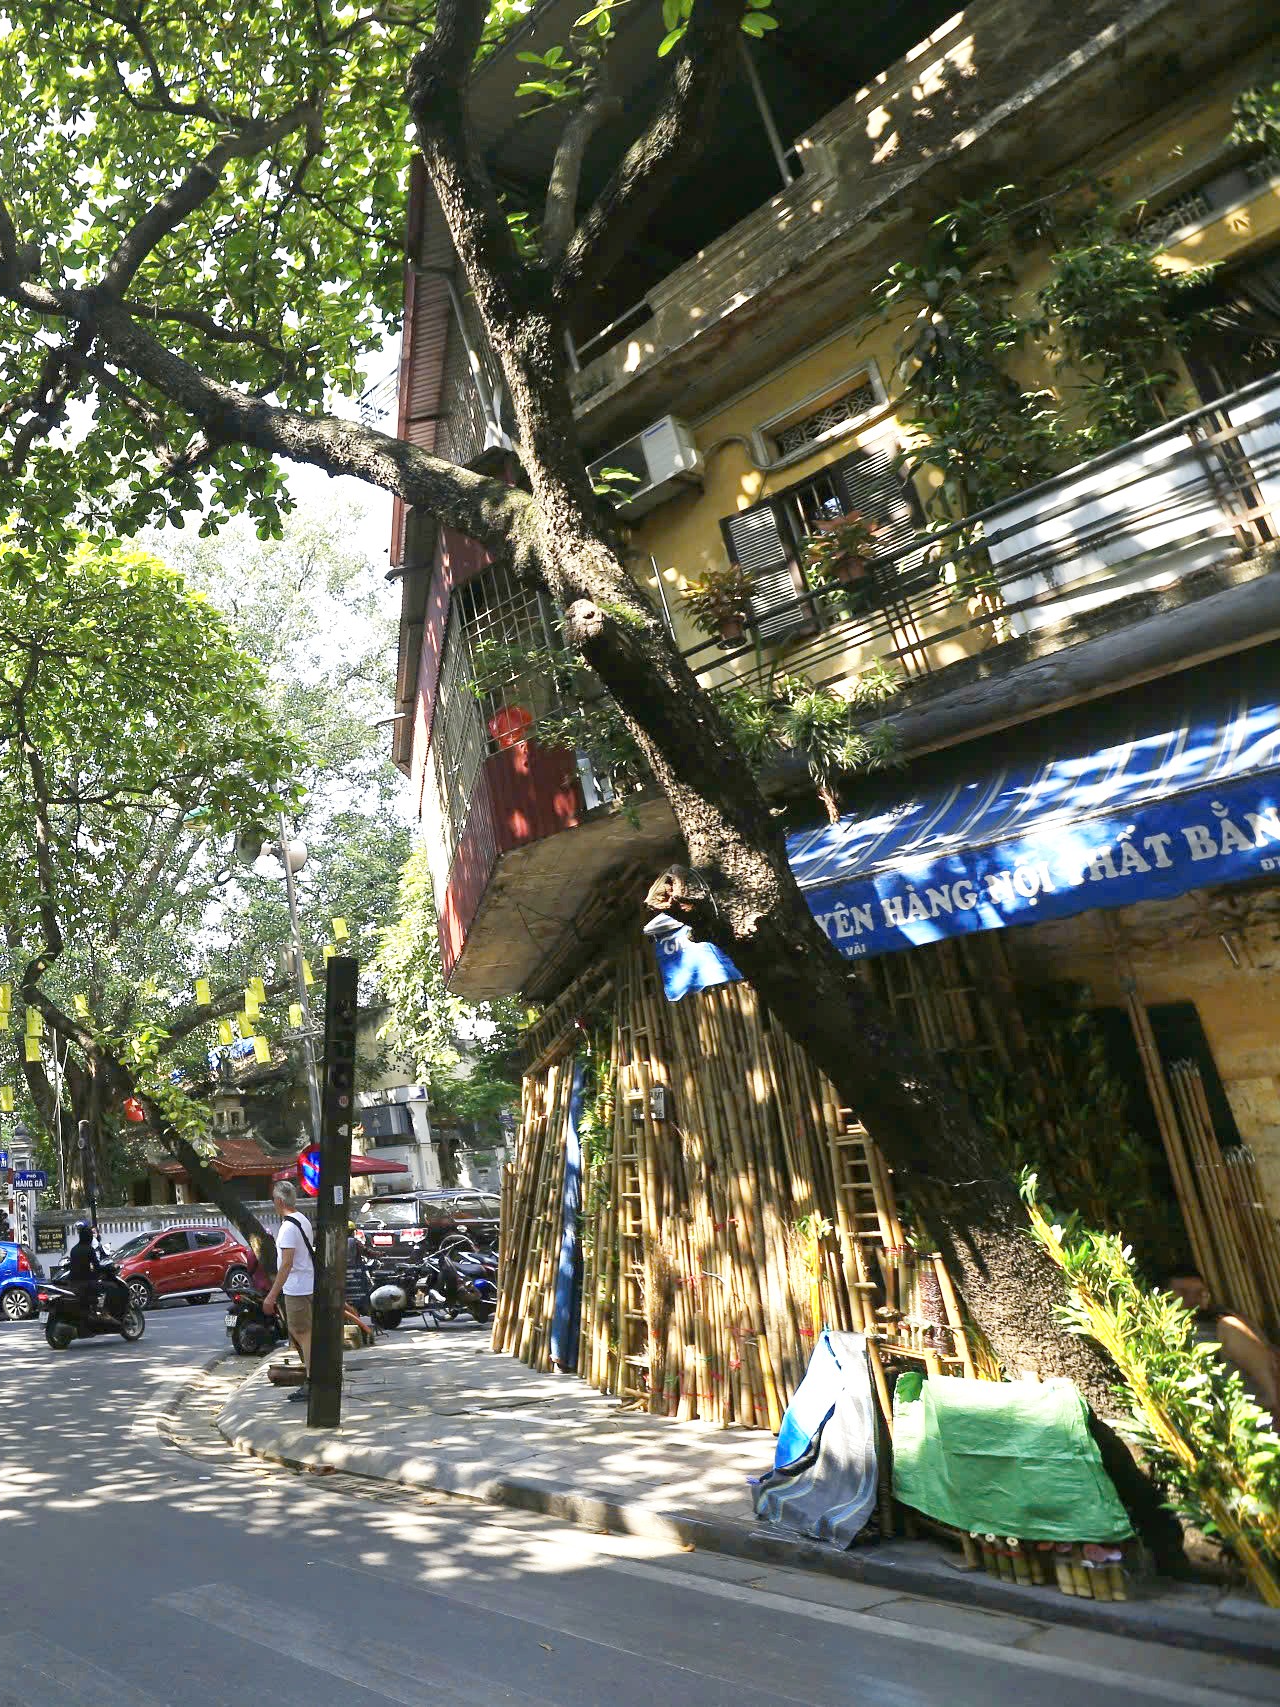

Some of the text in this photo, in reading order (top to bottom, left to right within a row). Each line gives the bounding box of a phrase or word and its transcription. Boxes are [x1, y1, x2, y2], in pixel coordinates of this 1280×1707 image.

[880, 880, 978, 928] HÀNG
[984, 857, 1056, 906] NỘI
[1062, 824, 1174, 887] HẤT
[15, 1179, 43, 1188] HÀNG GÀ
